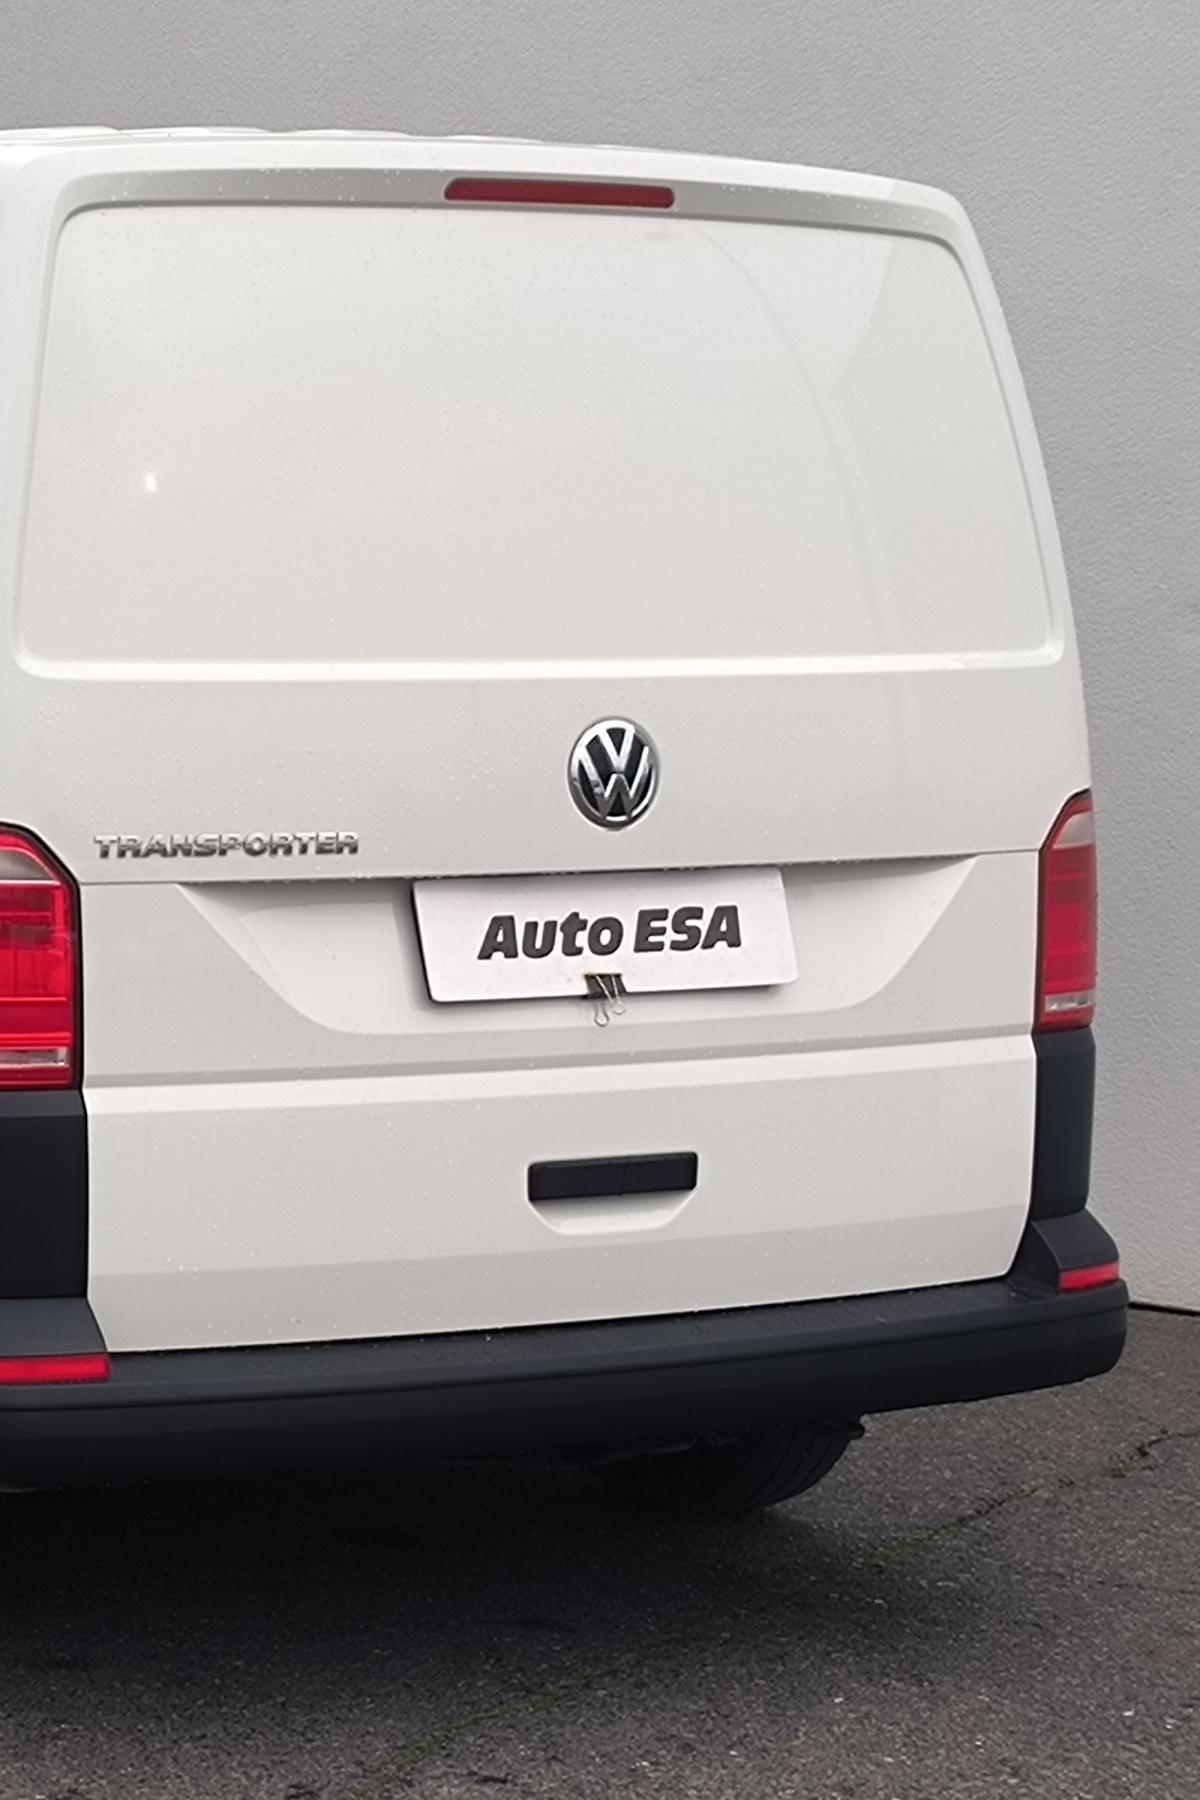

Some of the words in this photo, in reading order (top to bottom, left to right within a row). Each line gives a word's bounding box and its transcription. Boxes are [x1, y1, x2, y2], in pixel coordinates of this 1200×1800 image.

[94, 831, 359, 859] TRANSPORTER
[478, 911, 623, 960] Auto
[634, 905, 741, 953] ESA
